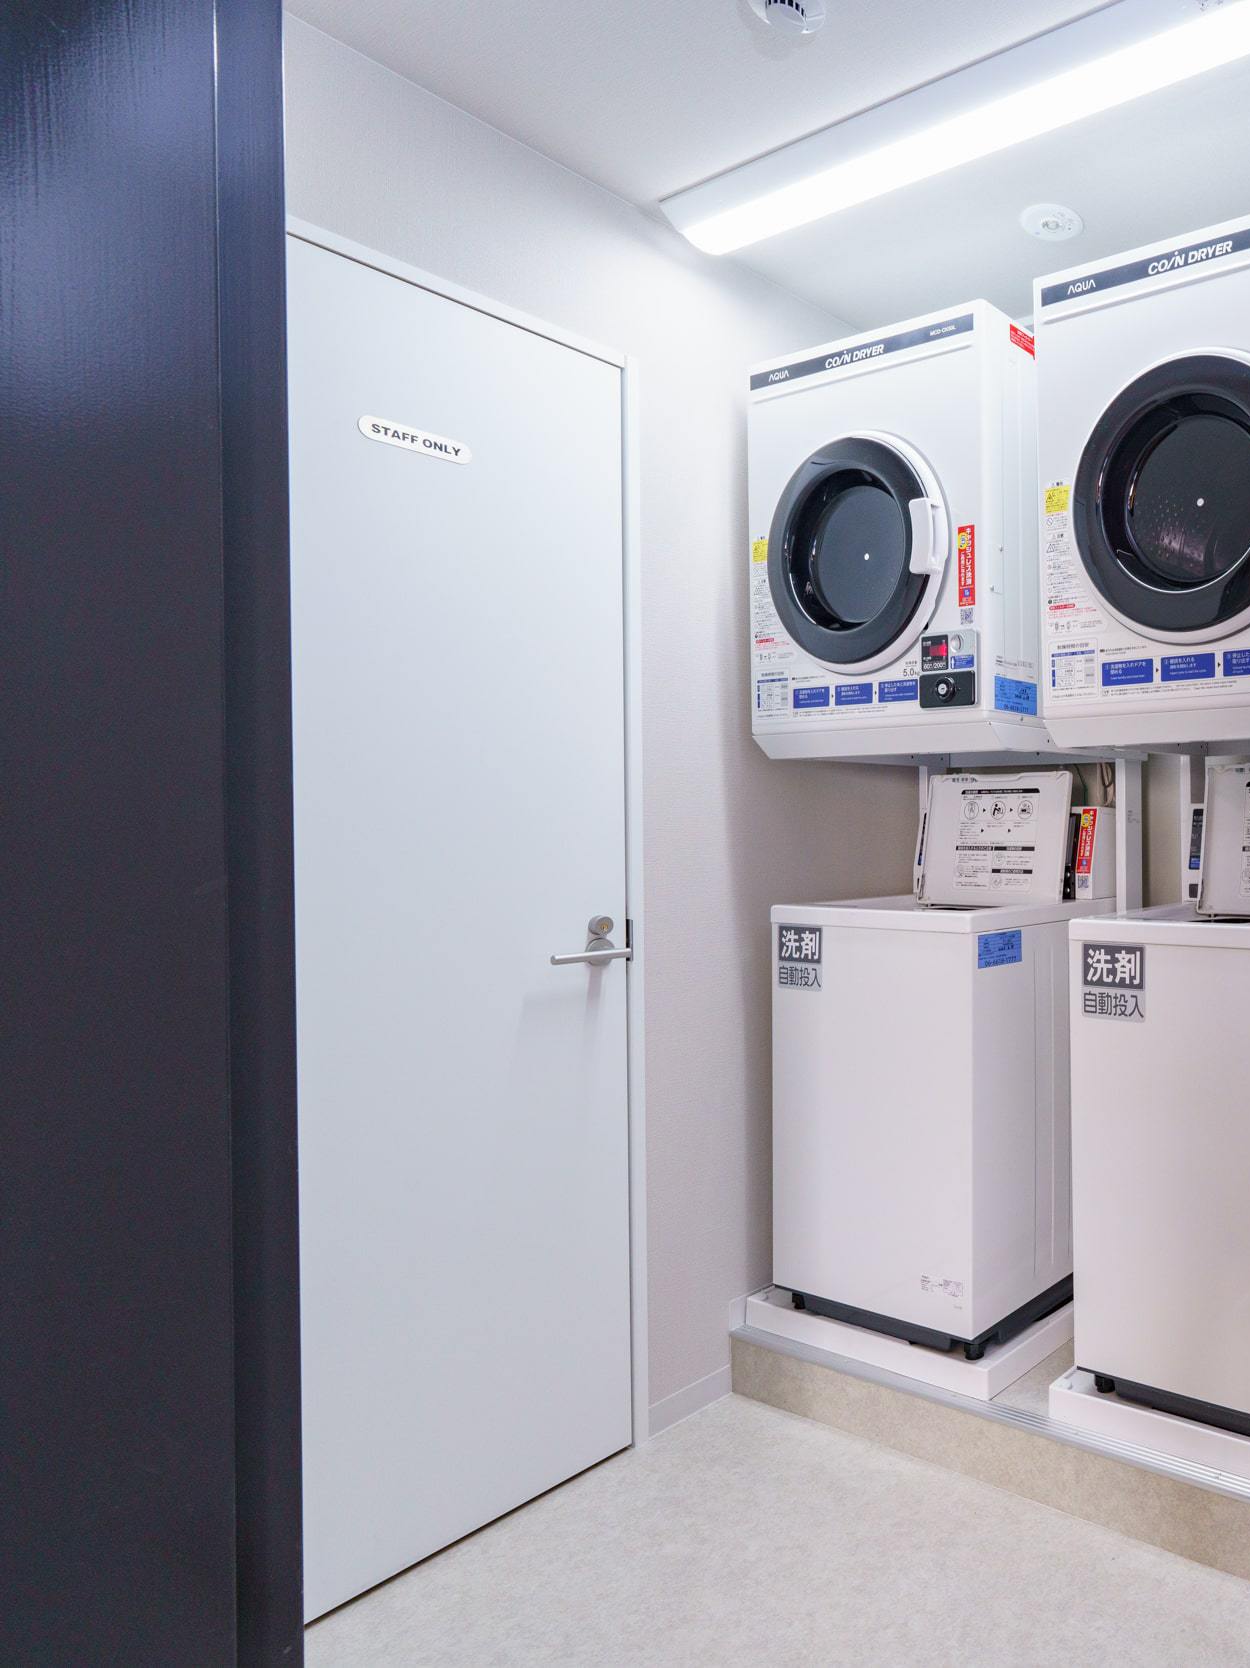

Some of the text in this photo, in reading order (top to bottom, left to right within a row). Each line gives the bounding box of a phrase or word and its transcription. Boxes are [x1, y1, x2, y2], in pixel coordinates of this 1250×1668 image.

[1148, 240, 1233, 276] COIN DRYER
[1067, 279, 1096, 295] AQUA
[825, 343, 885, 369] COIN DRYER
[768, 370, 790, 382] AQUA
[371, 423, 461, 457] STAFF ONLY
[781, 930, 820, 959] 洗剤
[779, 965, 821, 988] 自動投入
[1086, 949, 1141, 985] 洗剤
[1083, 990, 1144, 1018] 自動投入
